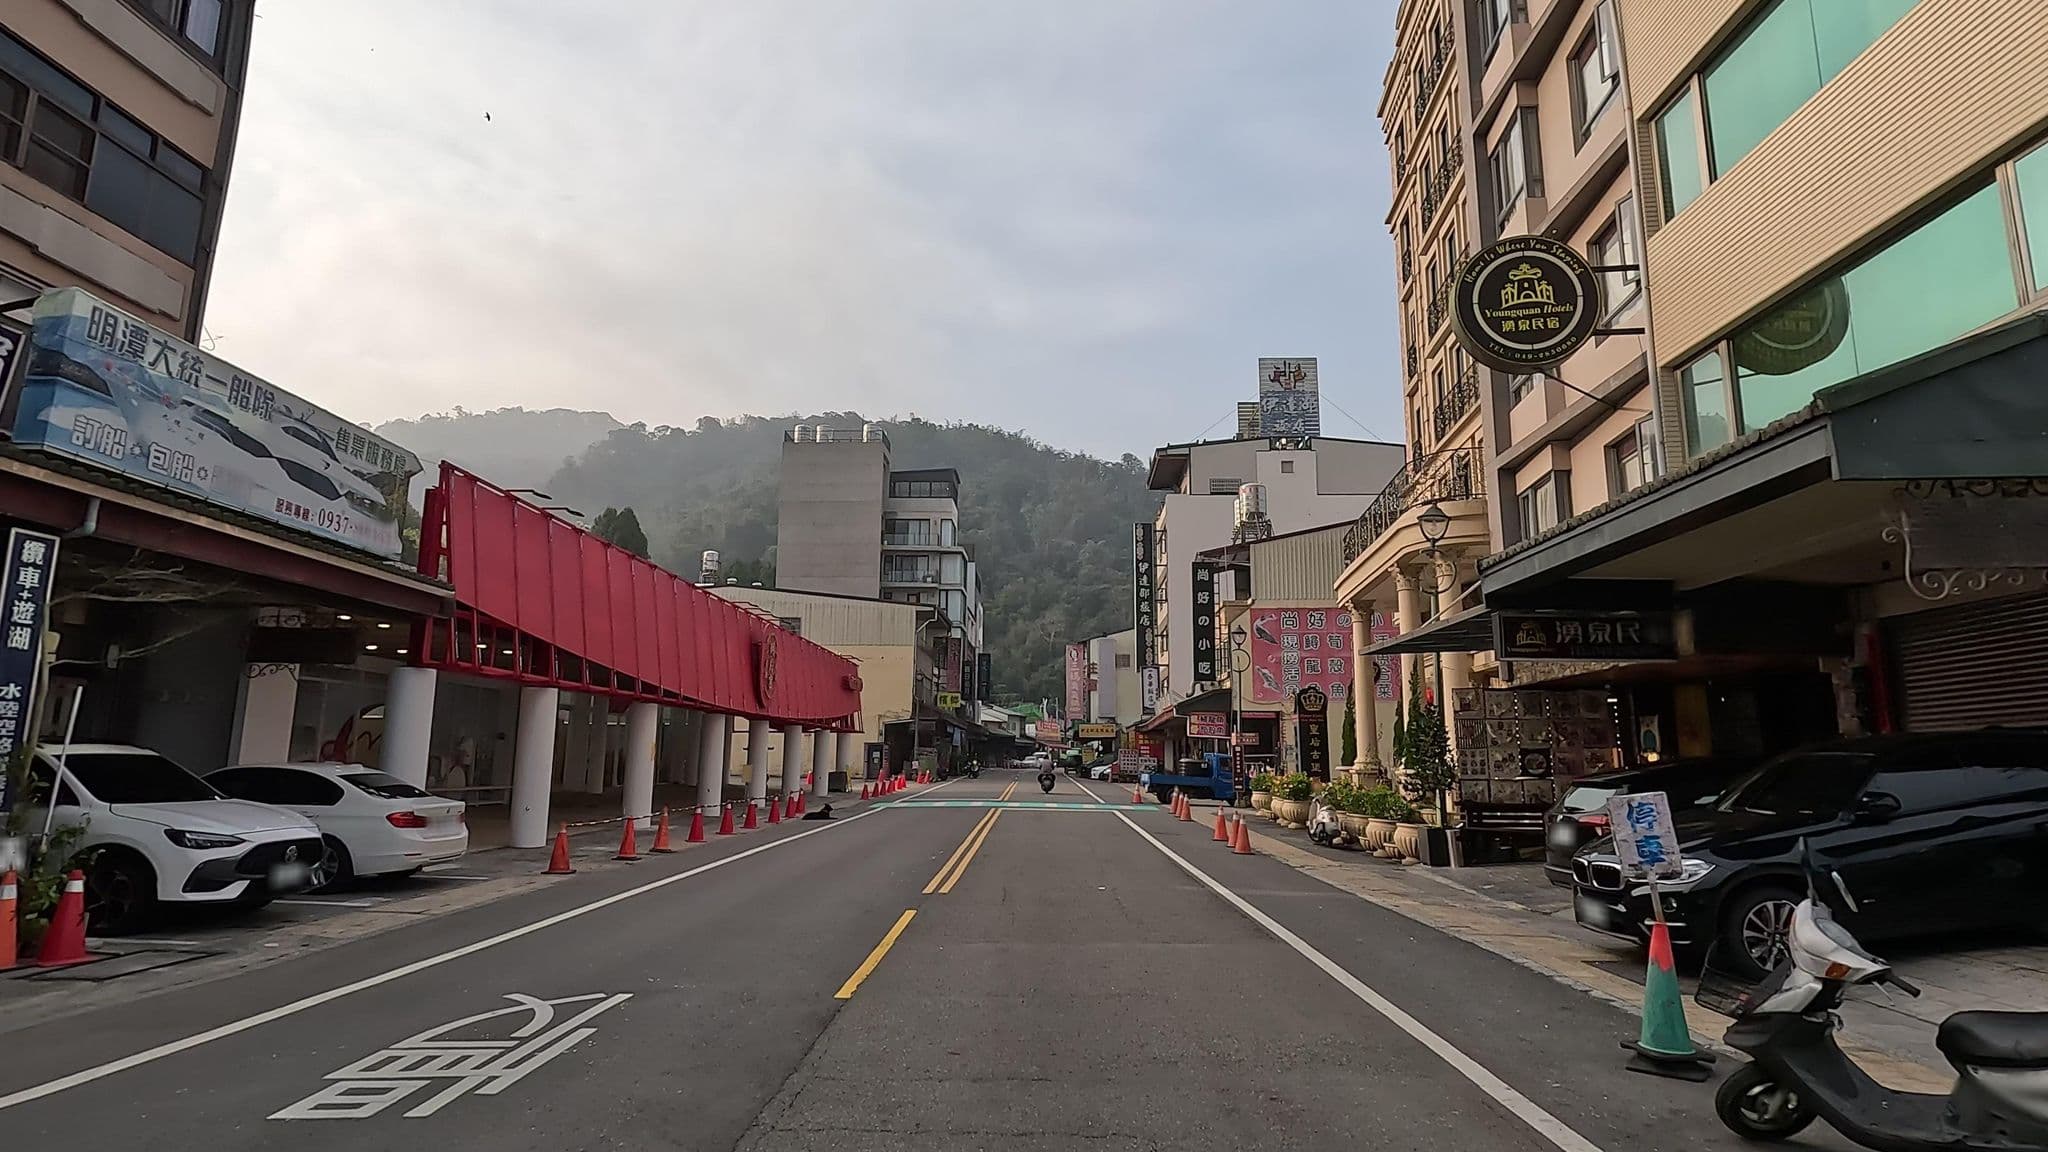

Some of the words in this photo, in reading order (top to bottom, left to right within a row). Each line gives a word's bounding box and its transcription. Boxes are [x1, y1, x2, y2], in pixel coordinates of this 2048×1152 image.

[1464, 260, 1485, 283] Home
[1496, 241, 1525, 255] Where
[1530, 239, 1548, 250] You
[1484, 305, 1541, 318] Youngquan
[1543, 303, 1574, 314] Hotels
[1502, 317, 1560, 332] 湧泉民宿
[86, 305, 275, 423] 明潭大統一船隊
[335, 426, 407, 480] 售票服務處
[71, 414, 128, 461] 訂船
[147, 441, 195, 484] 包船
[1197, 569, 1211, 674] 尚好の小吃
[1281, 611, 1400, 629] 尚好の小
[266, 992, 634, 1119] 慢
